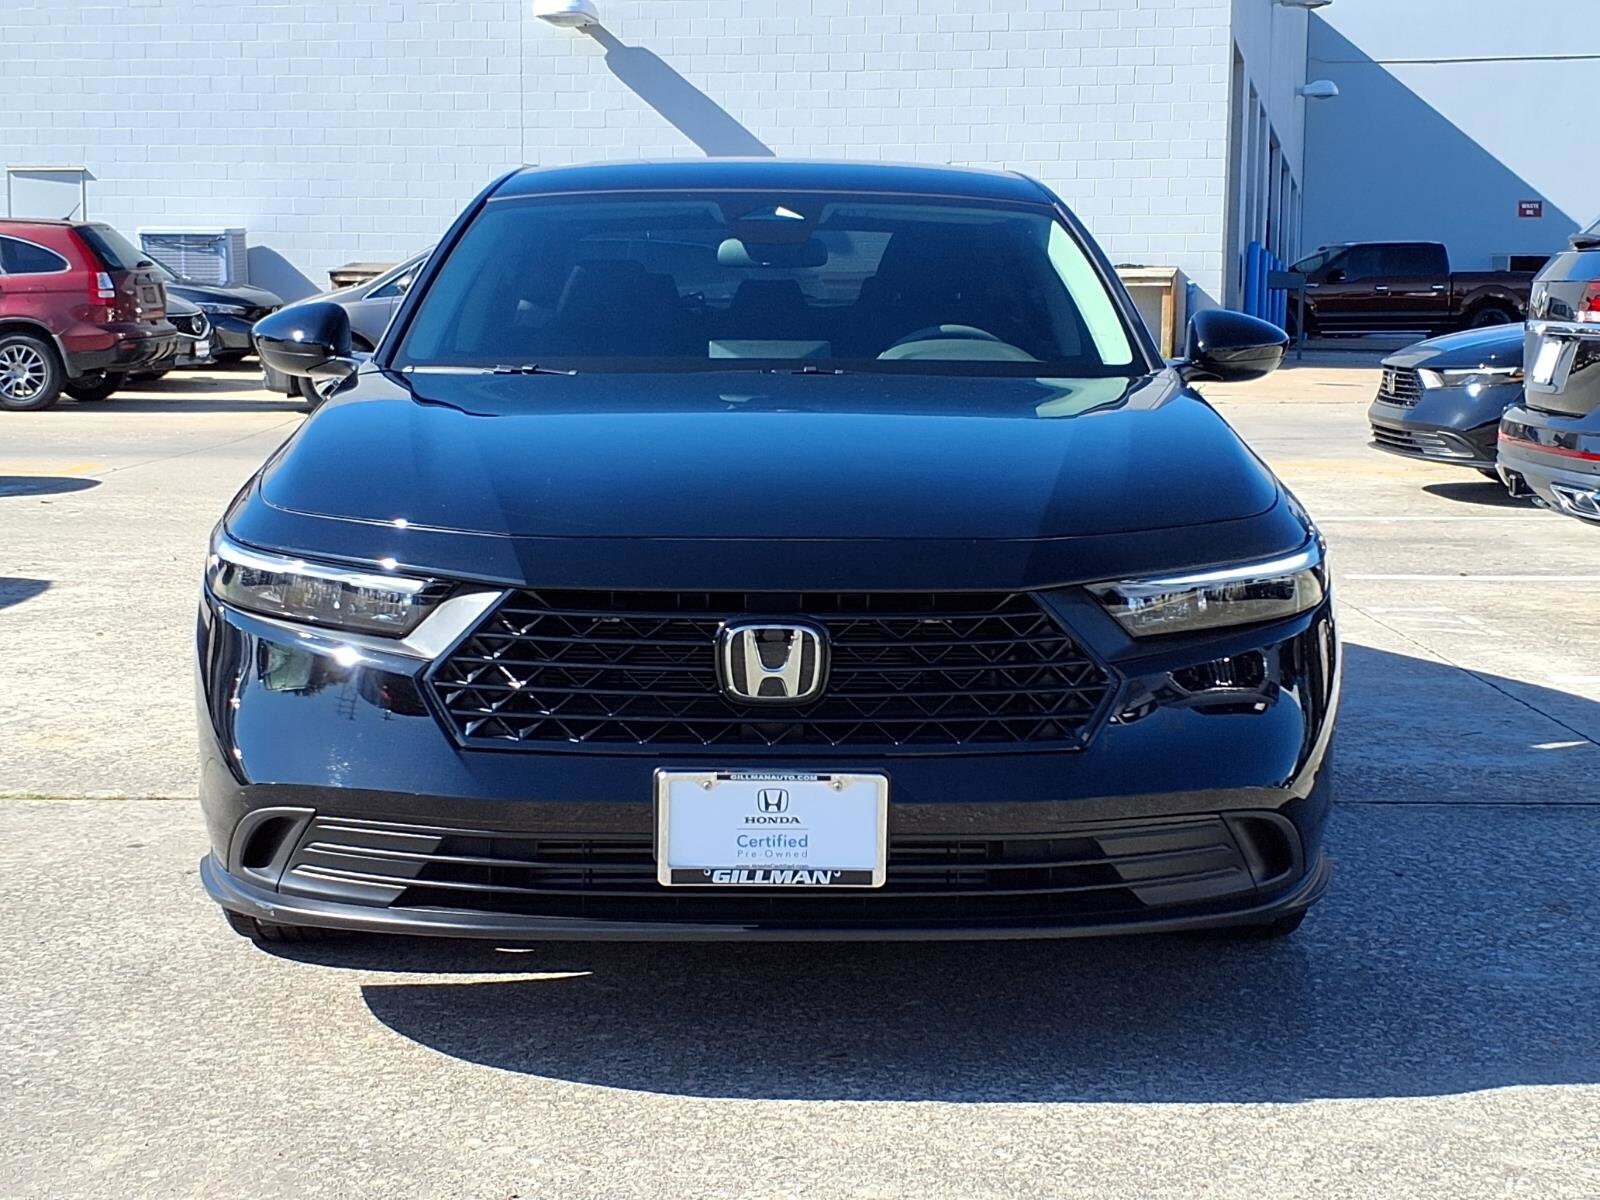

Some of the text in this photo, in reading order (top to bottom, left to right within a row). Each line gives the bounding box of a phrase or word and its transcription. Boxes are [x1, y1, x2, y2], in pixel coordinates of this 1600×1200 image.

[744, 816, 801, 824] HONDA
[736, 834, 808, 848] Certified
[712, 869, 832, 884] GILLMAN
